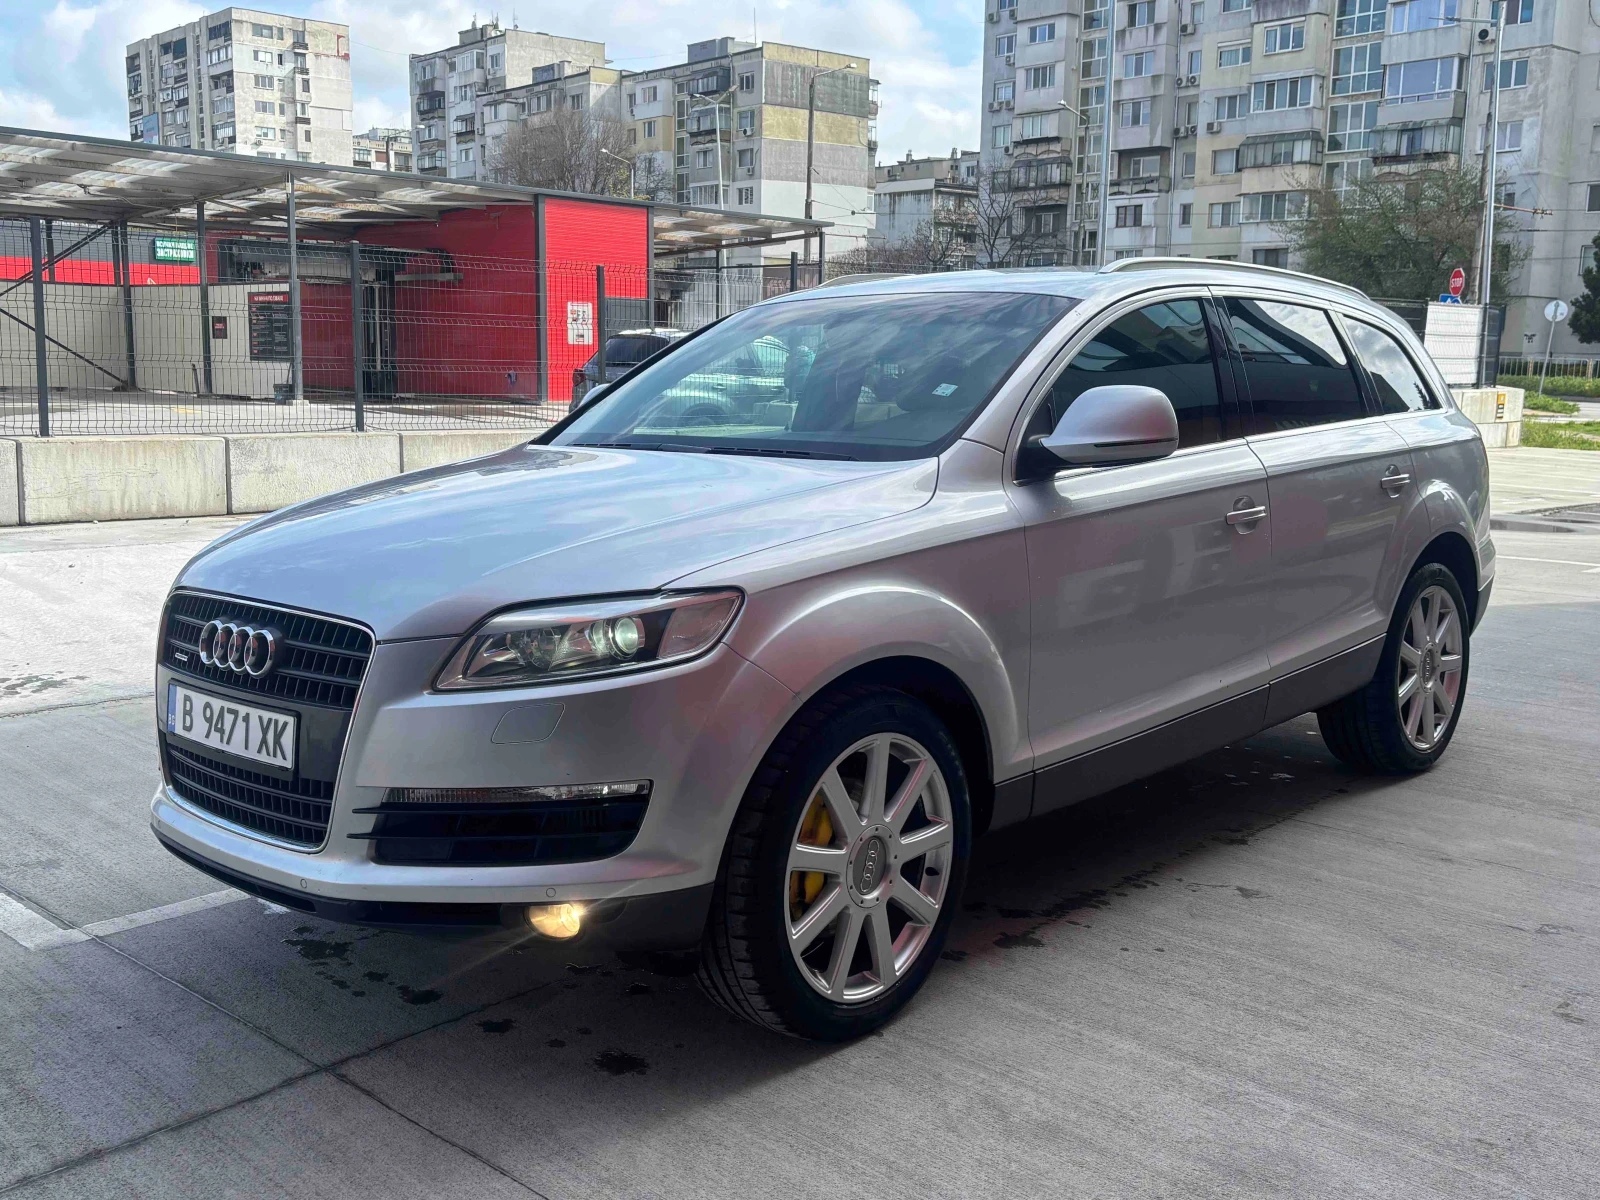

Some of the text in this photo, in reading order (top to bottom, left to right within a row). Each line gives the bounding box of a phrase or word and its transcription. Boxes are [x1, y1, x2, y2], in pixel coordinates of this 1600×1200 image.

[1451, 277, 1463, 288] STOP
[183, 694, 193, 732] B
[203, 701, 250, 750] 9471
[257, 714, 289, 761] XK
